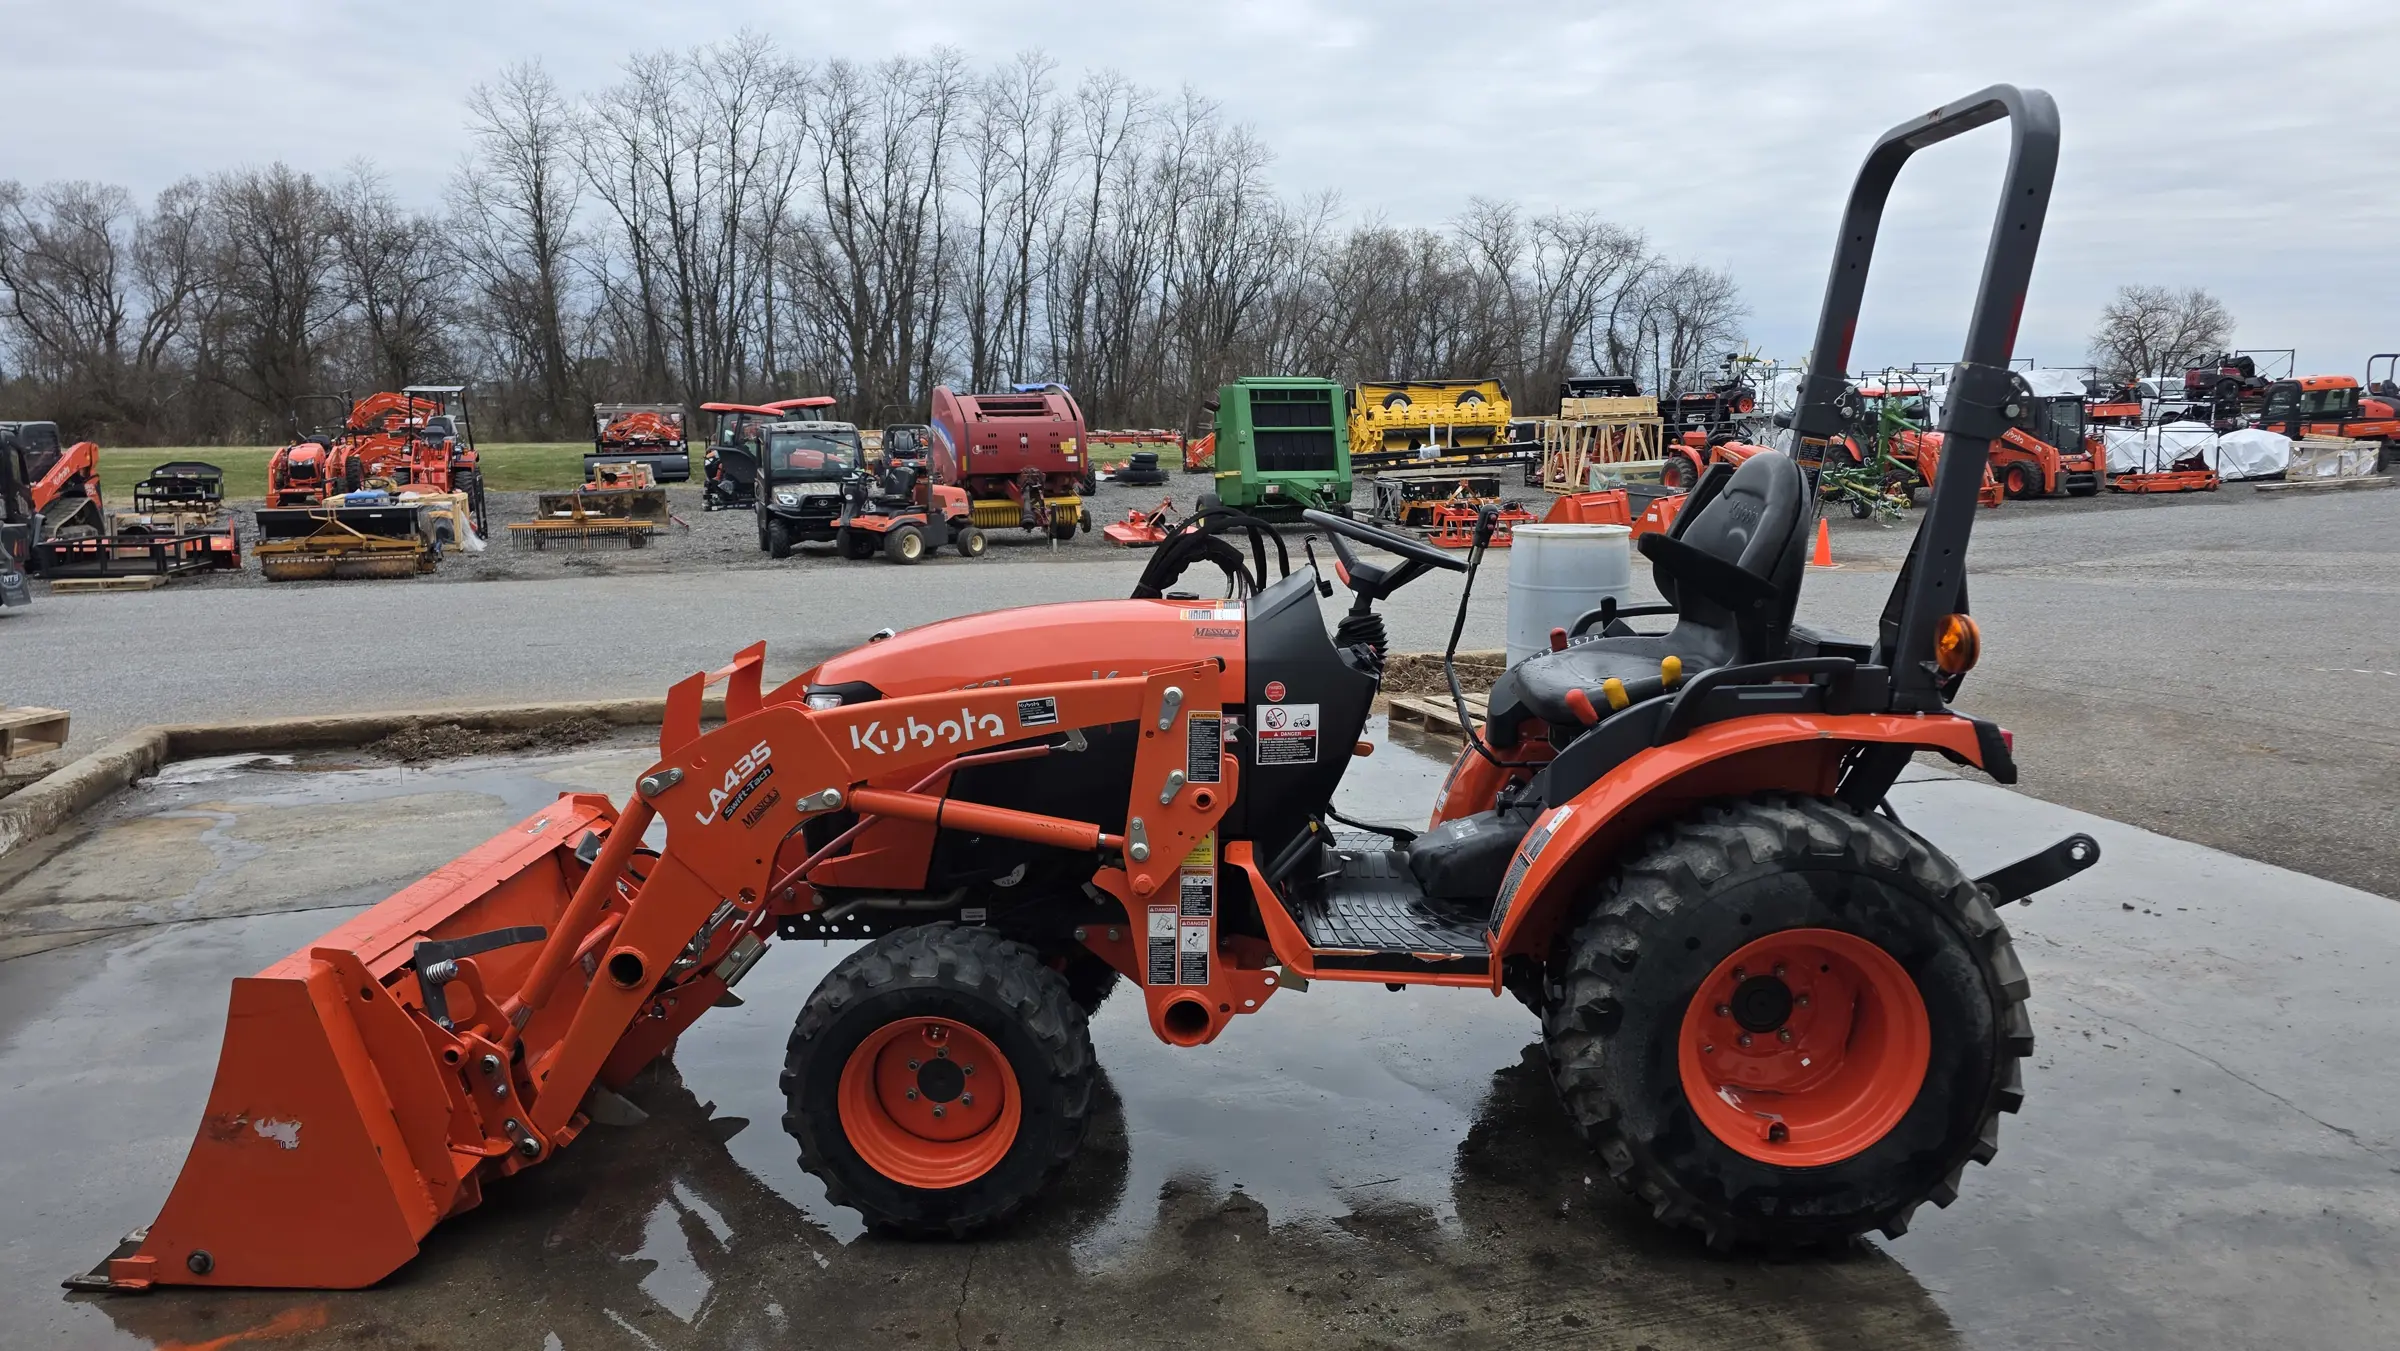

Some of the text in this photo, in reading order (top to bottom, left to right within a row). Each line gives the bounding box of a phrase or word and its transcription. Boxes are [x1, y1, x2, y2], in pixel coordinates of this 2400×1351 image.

[849, 707, 1005, 755] Kubota
[695, 739, 772, 826] LA435
[724, 768, 771, 817] Swift-Tach
